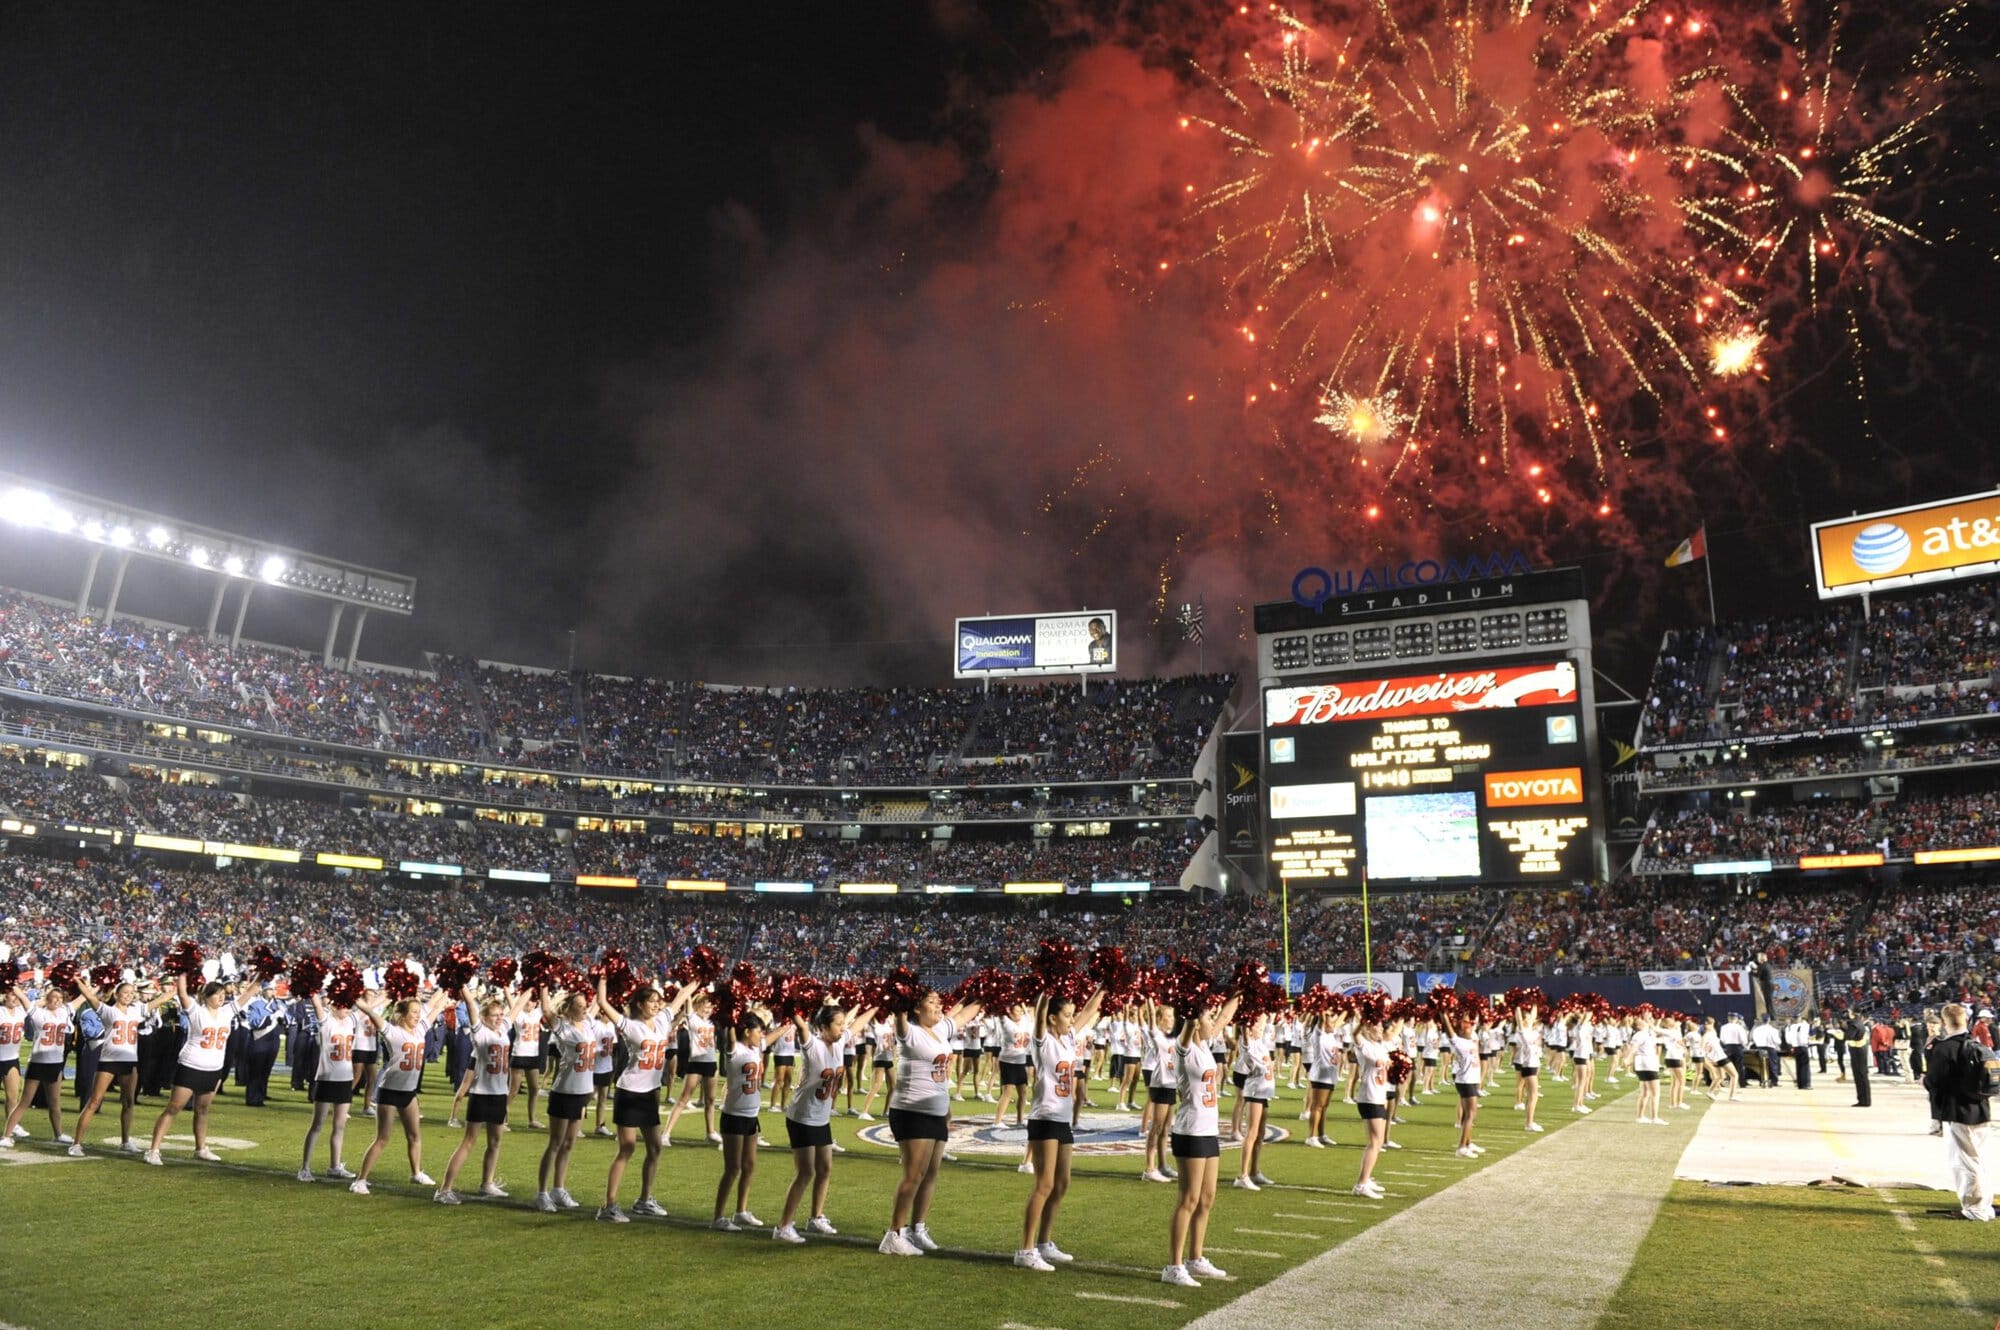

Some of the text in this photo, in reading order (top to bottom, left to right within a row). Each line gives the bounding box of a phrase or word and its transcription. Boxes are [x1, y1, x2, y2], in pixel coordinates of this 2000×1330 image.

[1922, 516, 2000, 556] at&
[1291, 550, 1532, 614] QUALCOMM
[1341, 584, 1514, 613] STADIUM
[962, 634, 1031, 651] QUALCOMM
[975, 648, 1021, 658] Innovation
[1294, 671, 1497, 725] Budweiser
[1431, 717, 1450, 735] TO
[1372, 730, 1461, 750] DR PEPPER
[1725, 738, 1740, 746] TEXT
[1444, 744, 1491, 761] SHOW
[1226, 792, 1257, 806] Sprint
[1489, 776, 1579, 799] TOYOTA
[1716, 972, 1742, 993] N
[0, 1022, 24, 1045] 36
[40, 1022, 66, 1046] 36
[112, 1020, 139, 1046] 36
[200, 1026, 230, 1050] 36
[638, 1039, 669, 1070] 36
